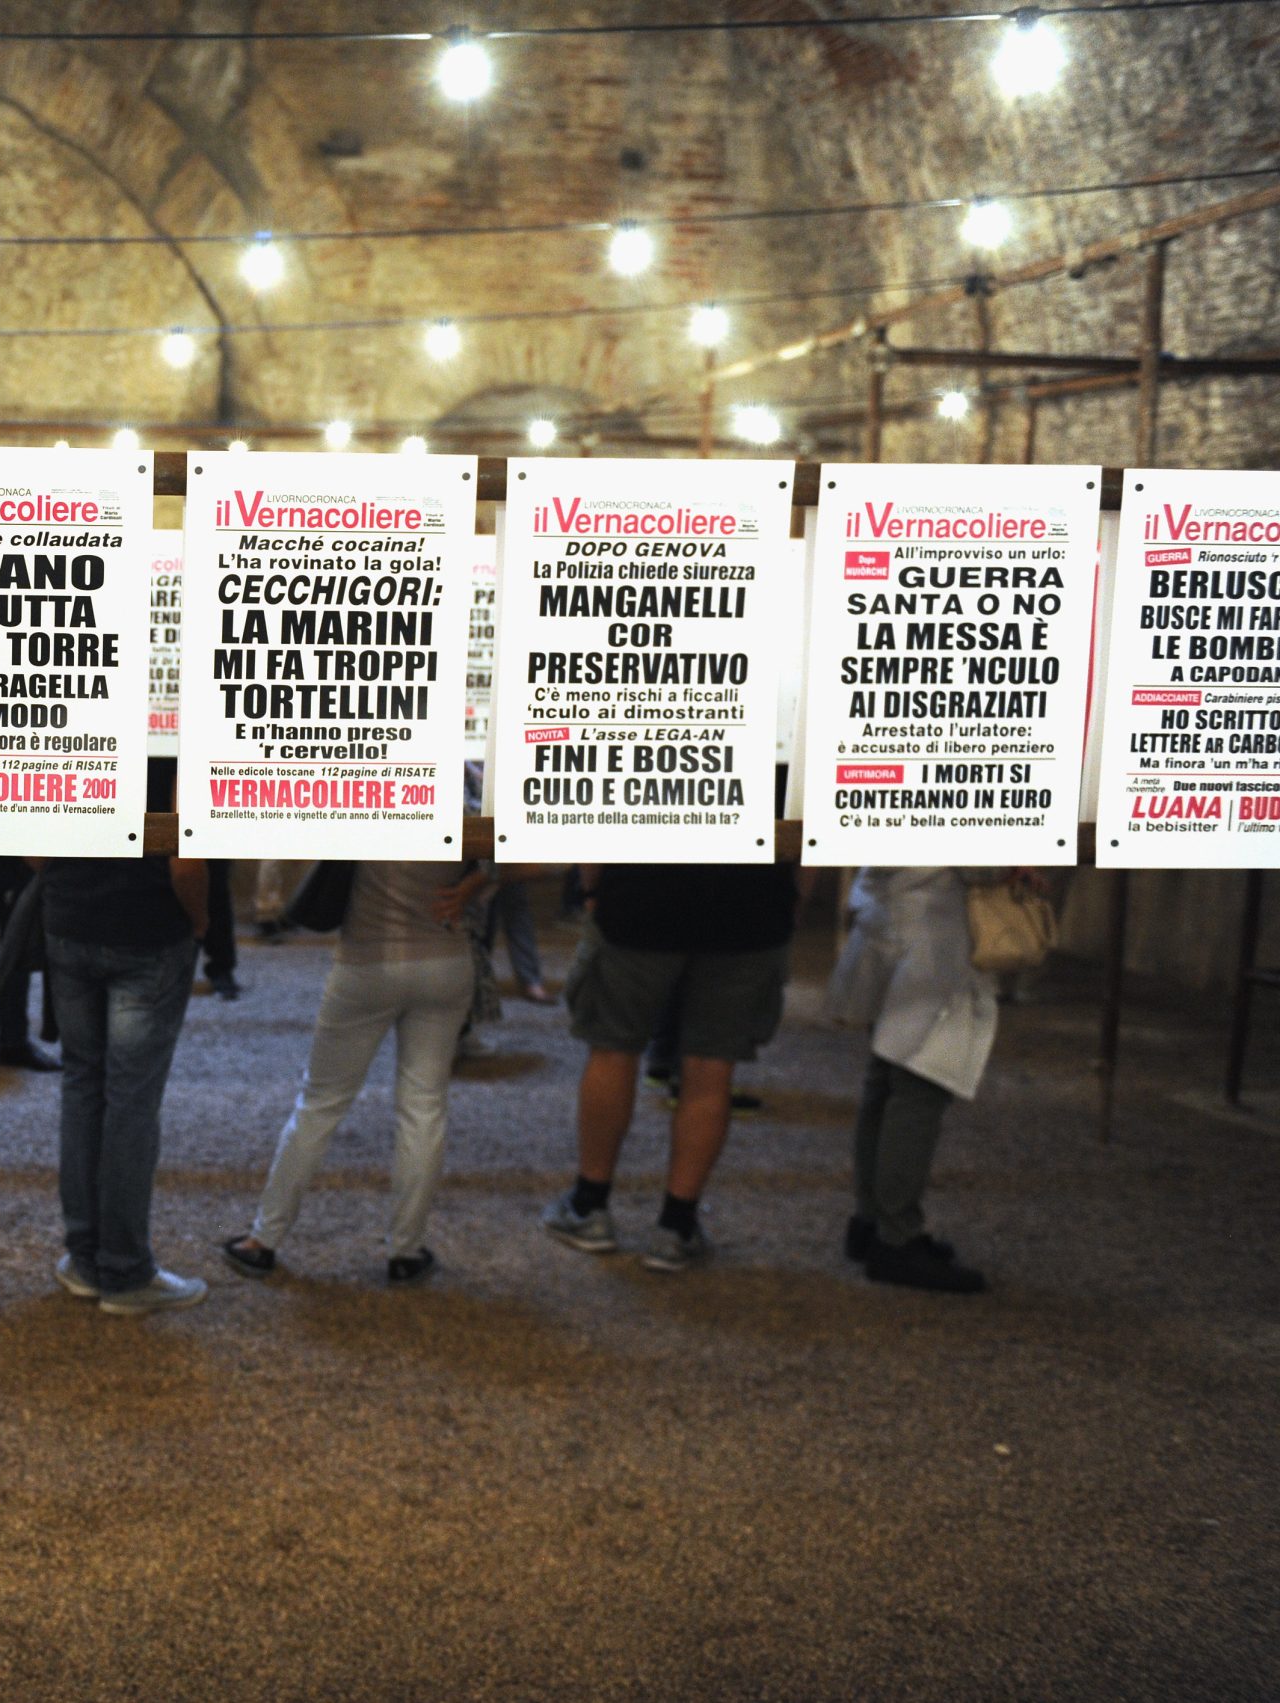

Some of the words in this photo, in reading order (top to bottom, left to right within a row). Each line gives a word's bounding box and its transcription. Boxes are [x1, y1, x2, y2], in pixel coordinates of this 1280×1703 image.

[216, 501, 230, 526] il
[235, 491, 421, 529] Vernacoliere
[533, 507, 547, 532] il
[553, 497, 736, 534] Vernacoliere
[846, 512, 860, 537] il
[865, 502, 1045, 538] Vernacoliere
[1145, 515, 1158, 539] il
[10, 531, 123, 548] collaudata
[238, 534, 325, 552] Macché
[331, 536, 426, 553] cocaina!
[565, 541, 628, 557] DOPO
[635, 541, 727, 558] GENOVA
[218, 553, 262, 570] L'ha
[269, 554, 357, 571] rovinato
[363, 555, 382, 571] la
[389, 556, 442, 575] gola!
[894, 546, 1003, 562] All'improvviso
[1008, 550, 1027, 559] un
[1031, 547, 1066, 560] urlo:
[1147, 552, 1189, 563] GUERRA
[1197, 550, 1268, 563] Rionosciuto
[898, 566, 1065, 589] GUERRA
[217, 573, 444, 607] CECCHIGORI:
[539, 584, 747, 619] MANGANELLI
[221, 608, 270, 645] LA
[280, 609, 434, 646] MARINI
[1139, 604, 1213, 631] BUSCE
[1216, 605, 1245, 631] MI
[607, 622, 673, 648] COR
[857, 622, 897, 651] LA
[905, 622, 1023, 651] MESSA
[1031, 617, 1049, 651] È
[6, 631, 120, 668] TORRE
[527, 651, 749, 686] PRESERVATIVO
[219, 683, 429, 721] TORTELLINI
[1133, 693, 1199, 703] ADDIACCIANTE
[862, 723, 944, 737] Arrestato
[1161, 709, 1190, 730] HO
[643, 728, 726, 741] LEGA-AN
[1130, 732, 1202, 754] LETTERE
[1204, 737, 1225, 754] AR
[259, 742, 275, 759] 'r
[279, 743, 388, 760] cervello!
[534, 744, 598, 773] FINI
[607, 745, 624, 773] E
[633, 744, 734, 774] BOSSI
[3, 760, 21, 770] 112
[21, 761, 58, 772] pagine
[62, 760, 73, 771] di
[76, 761, 117, 771] RISATE
[843, 769, 897, 780] URTIMORA
[82, 777, 117, 800] 2001
[523, 777, 594, 806] CULO
[602, 778, 616, 806] E
[623, 777, 745, 807] CAMICIA
[835, 789, 969, 810] CONTERANNO
[973, 789, 995, 809] IN
[999, 788, 1053, 809] EURO
[210, 809, 258, 819] Barzellette,
[260, 810, 284, 819] storie
[294, 811, 328, 820] vignette
[349, 812, 370, 820] anno
[371, 811, 380, 820] di
[381, 811, 434, 820] Vernacoliere
[1131, 795, 1222, 819] LUANA
[1128, 821, 1141, 832] la
[1145, 821, 1219, 833] bebisitter
